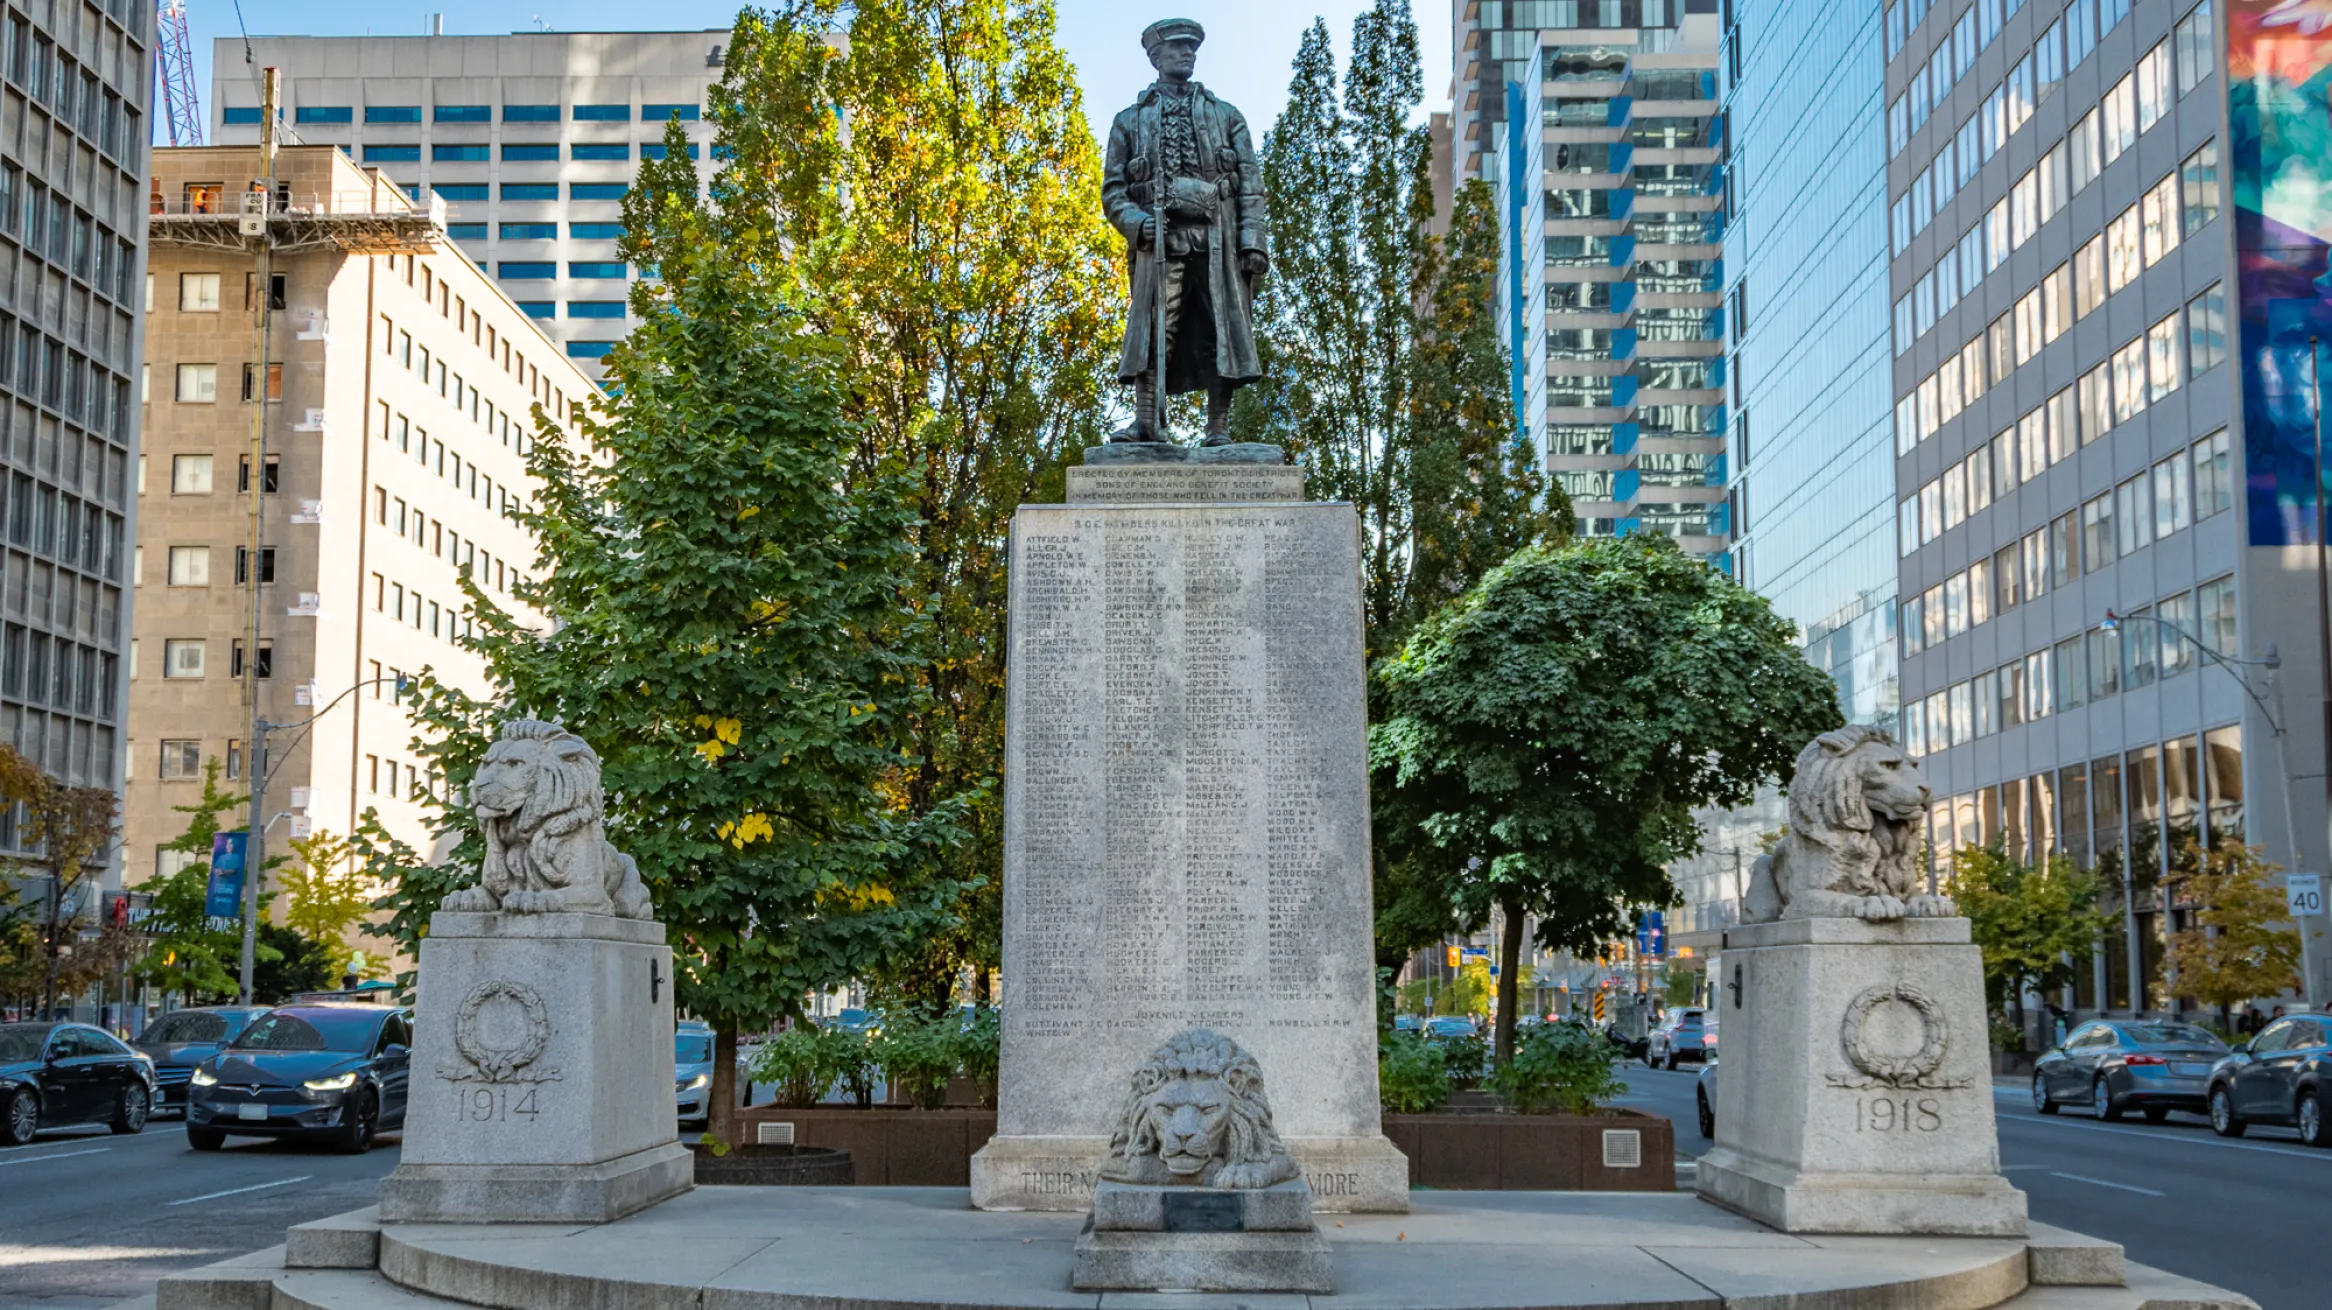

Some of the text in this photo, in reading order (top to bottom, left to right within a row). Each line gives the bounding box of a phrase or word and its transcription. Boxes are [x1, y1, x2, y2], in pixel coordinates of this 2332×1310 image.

[2294, 892, 2319, 910] 40
[459, 1088, 539, 1122] 1914
[1856, 1098, 1941, 1132] 1918
[1022, 1172, 1073, 1195] THEIR
